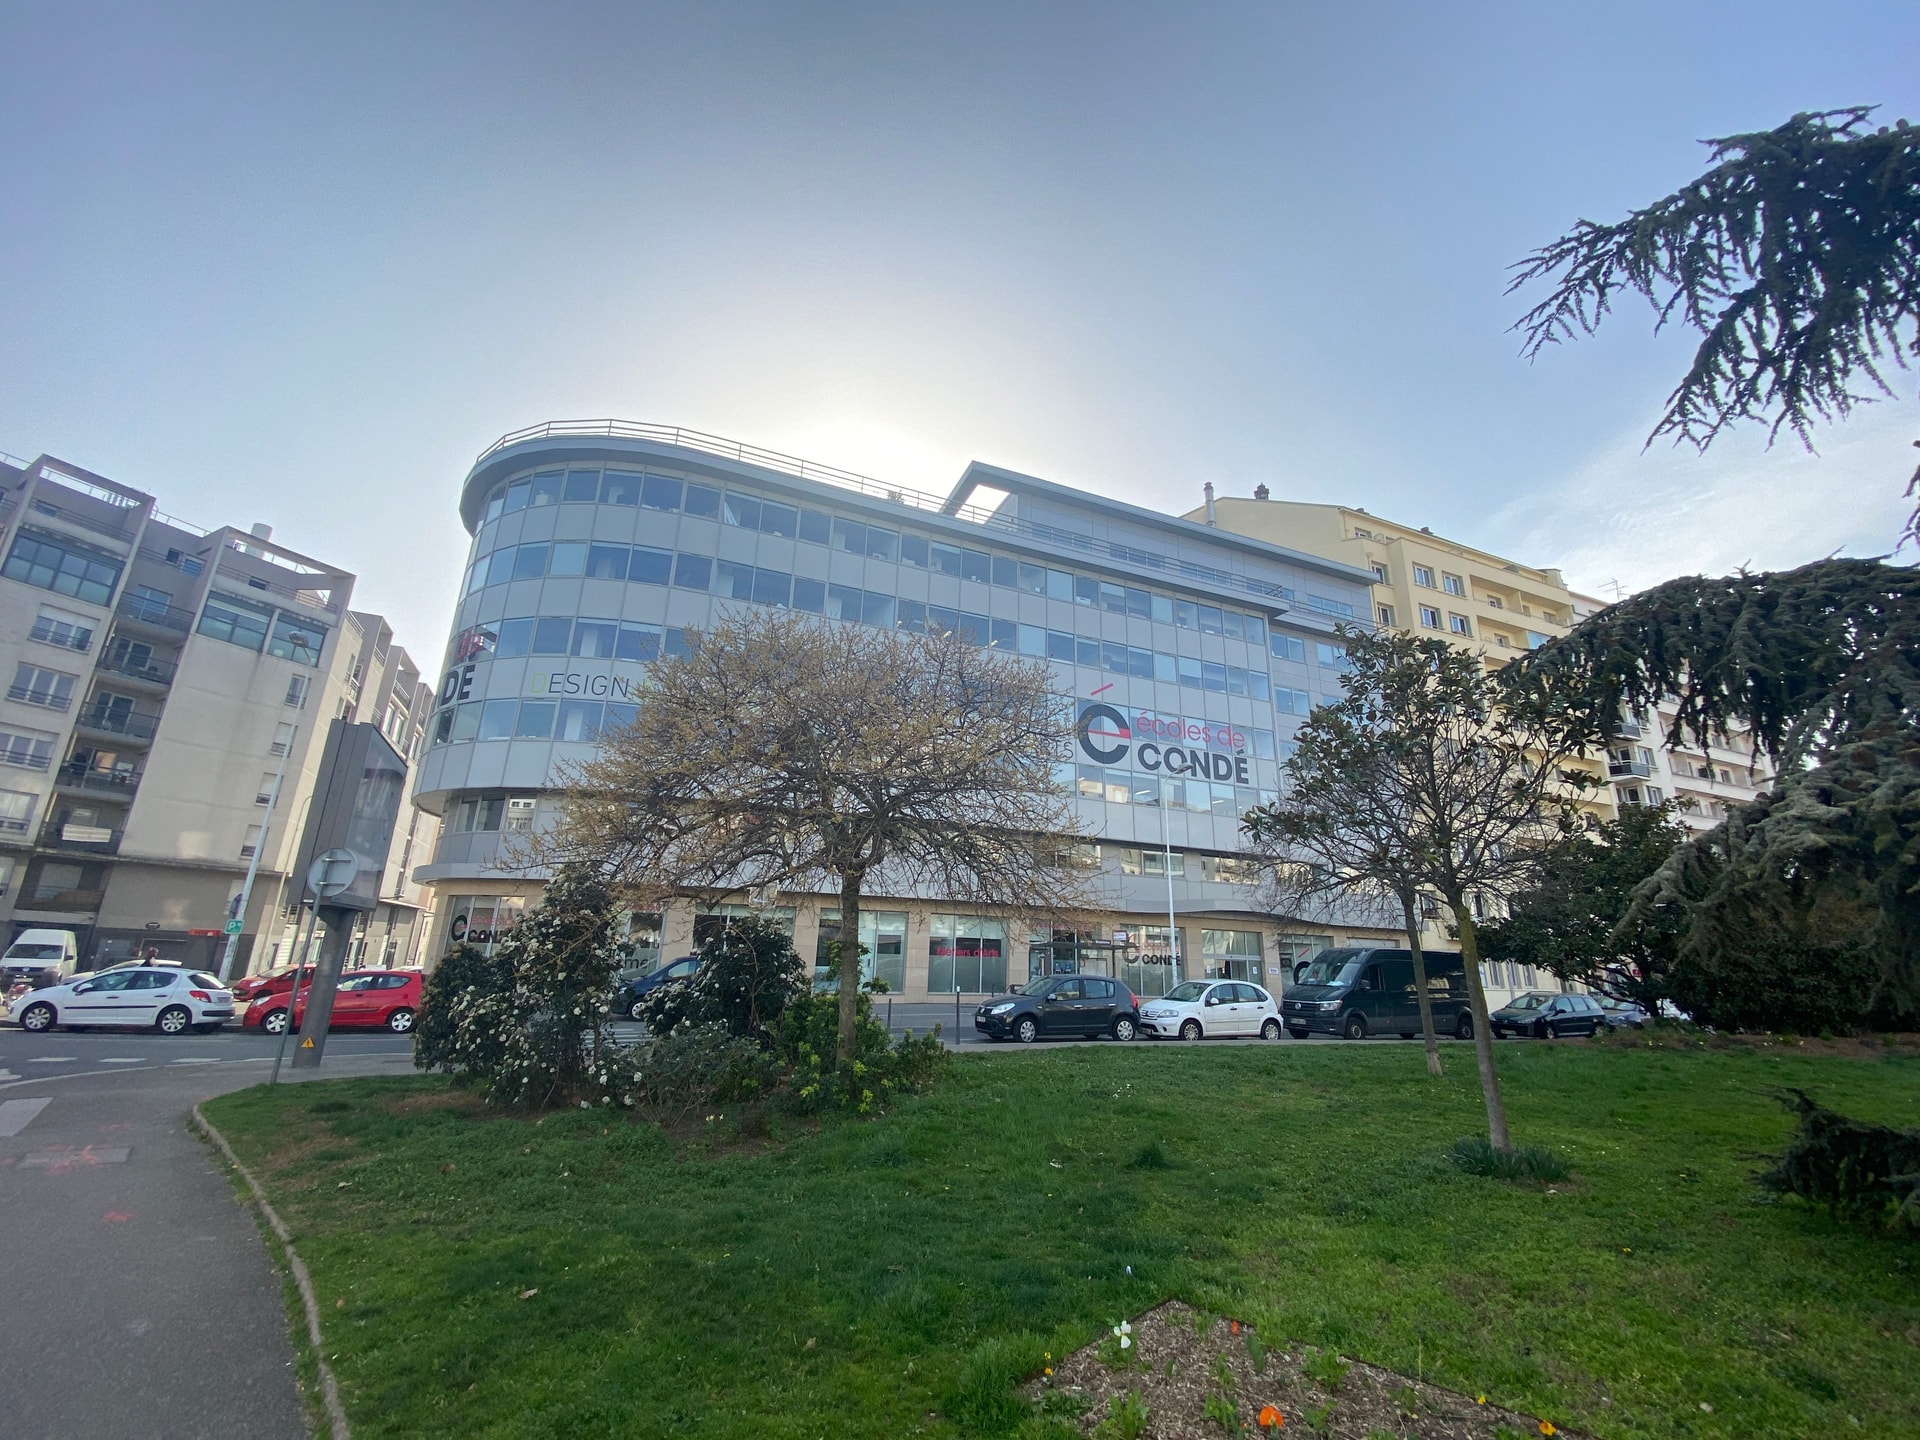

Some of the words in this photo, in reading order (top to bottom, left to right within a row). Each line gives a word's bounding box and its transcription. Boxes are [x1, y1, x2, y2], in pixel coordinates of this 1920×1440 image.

[530, 672, 629, 698] DESIGN
[1136, 710, 1211, 743] écoles
[1216, 724, 1245, 748] de
[1138, 743, 1249, 785] CONDÉ
